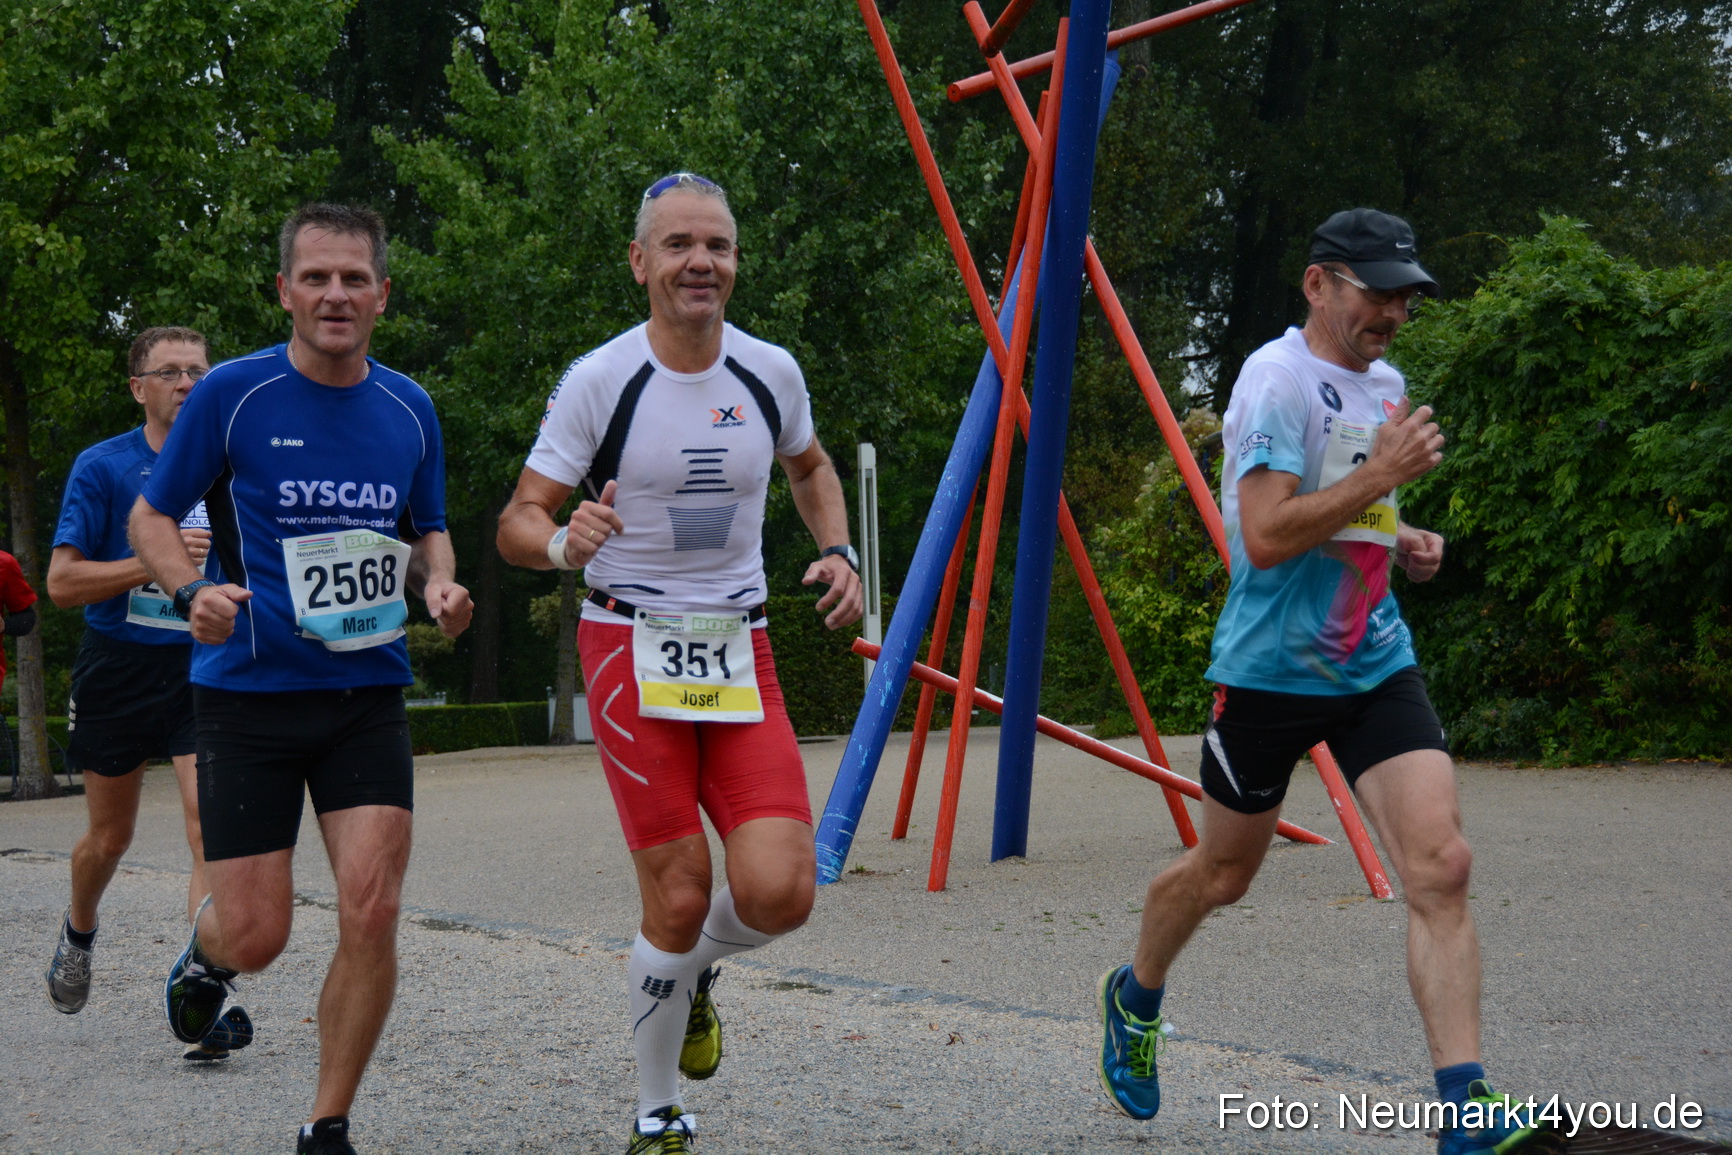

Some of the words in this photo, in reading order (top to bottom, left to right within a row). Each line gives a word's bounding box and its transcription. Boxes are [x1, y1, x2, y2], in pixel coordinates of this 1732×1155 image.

[282, 439, 304, 447] JAKO
[279, 480, 397, 510] SYSCAD
[276, 515, 396, 528] www.metallbau-cad.de
[296, 547, 339, 558] NeuerMarkt
[304, 554, 397, 610] 2568
[342, 616, 378, 635] Marc
[645, 622, 685, 632] NeuerMarkt
[692, 617, 741, 632] BOCK
[661, 640, 731, 680] 351
[680, 690, 720, 707] Josef
[641, 985, 670, 999] cep
